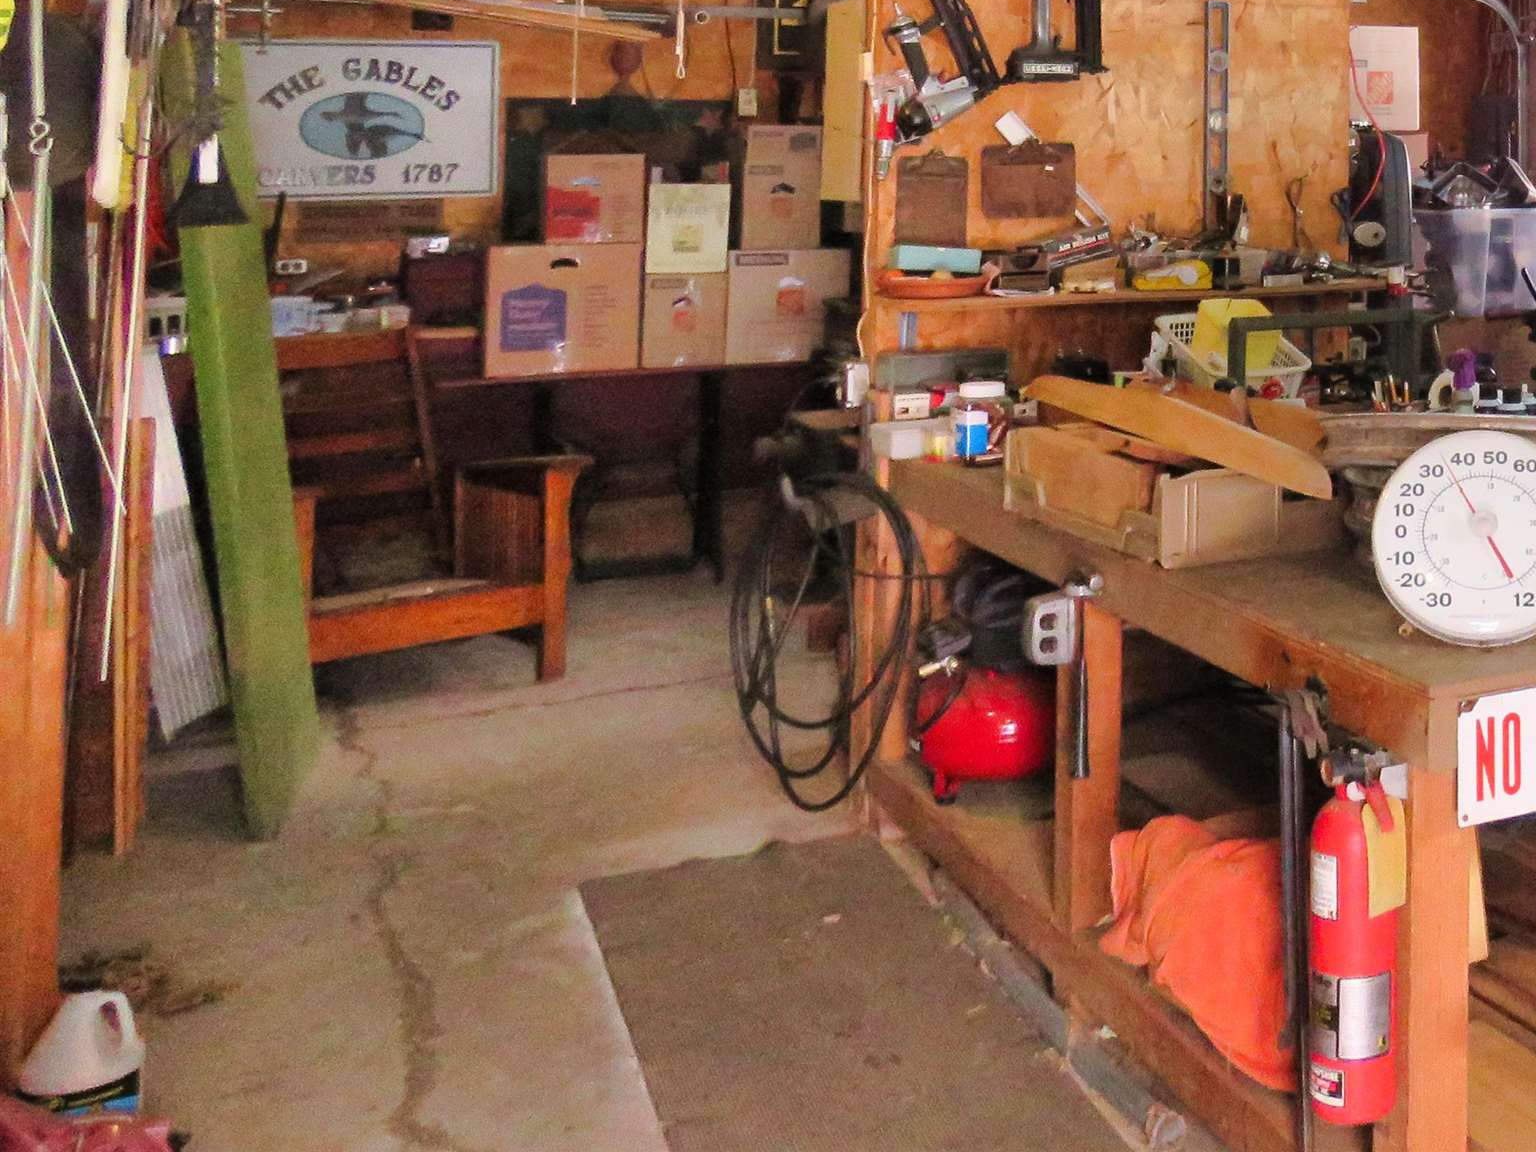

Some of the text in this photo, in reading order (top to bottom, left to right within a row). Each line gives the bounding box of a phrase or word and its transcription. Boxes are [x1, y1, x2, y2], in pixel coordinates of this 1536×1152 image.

[256, 57, 461, 112] THE GABLES
[402, 162, 460, 185] 1787
[1450, 452, 1476, 466] 40
[1482, 450, 1508, 465] 50
[1419, 464, 1444, 478] 30
[1399, 483, 1425, 497] 20
[1394, 503, 1415, 517] 10
[1394, 524, 1407, 538] 0
[1386, 551, 1415, 566] -10
[1394, 572, 1426, 587] -20
[1419, 592, 1452, 607] -30
[1475, 712, 1522, 802] NO
